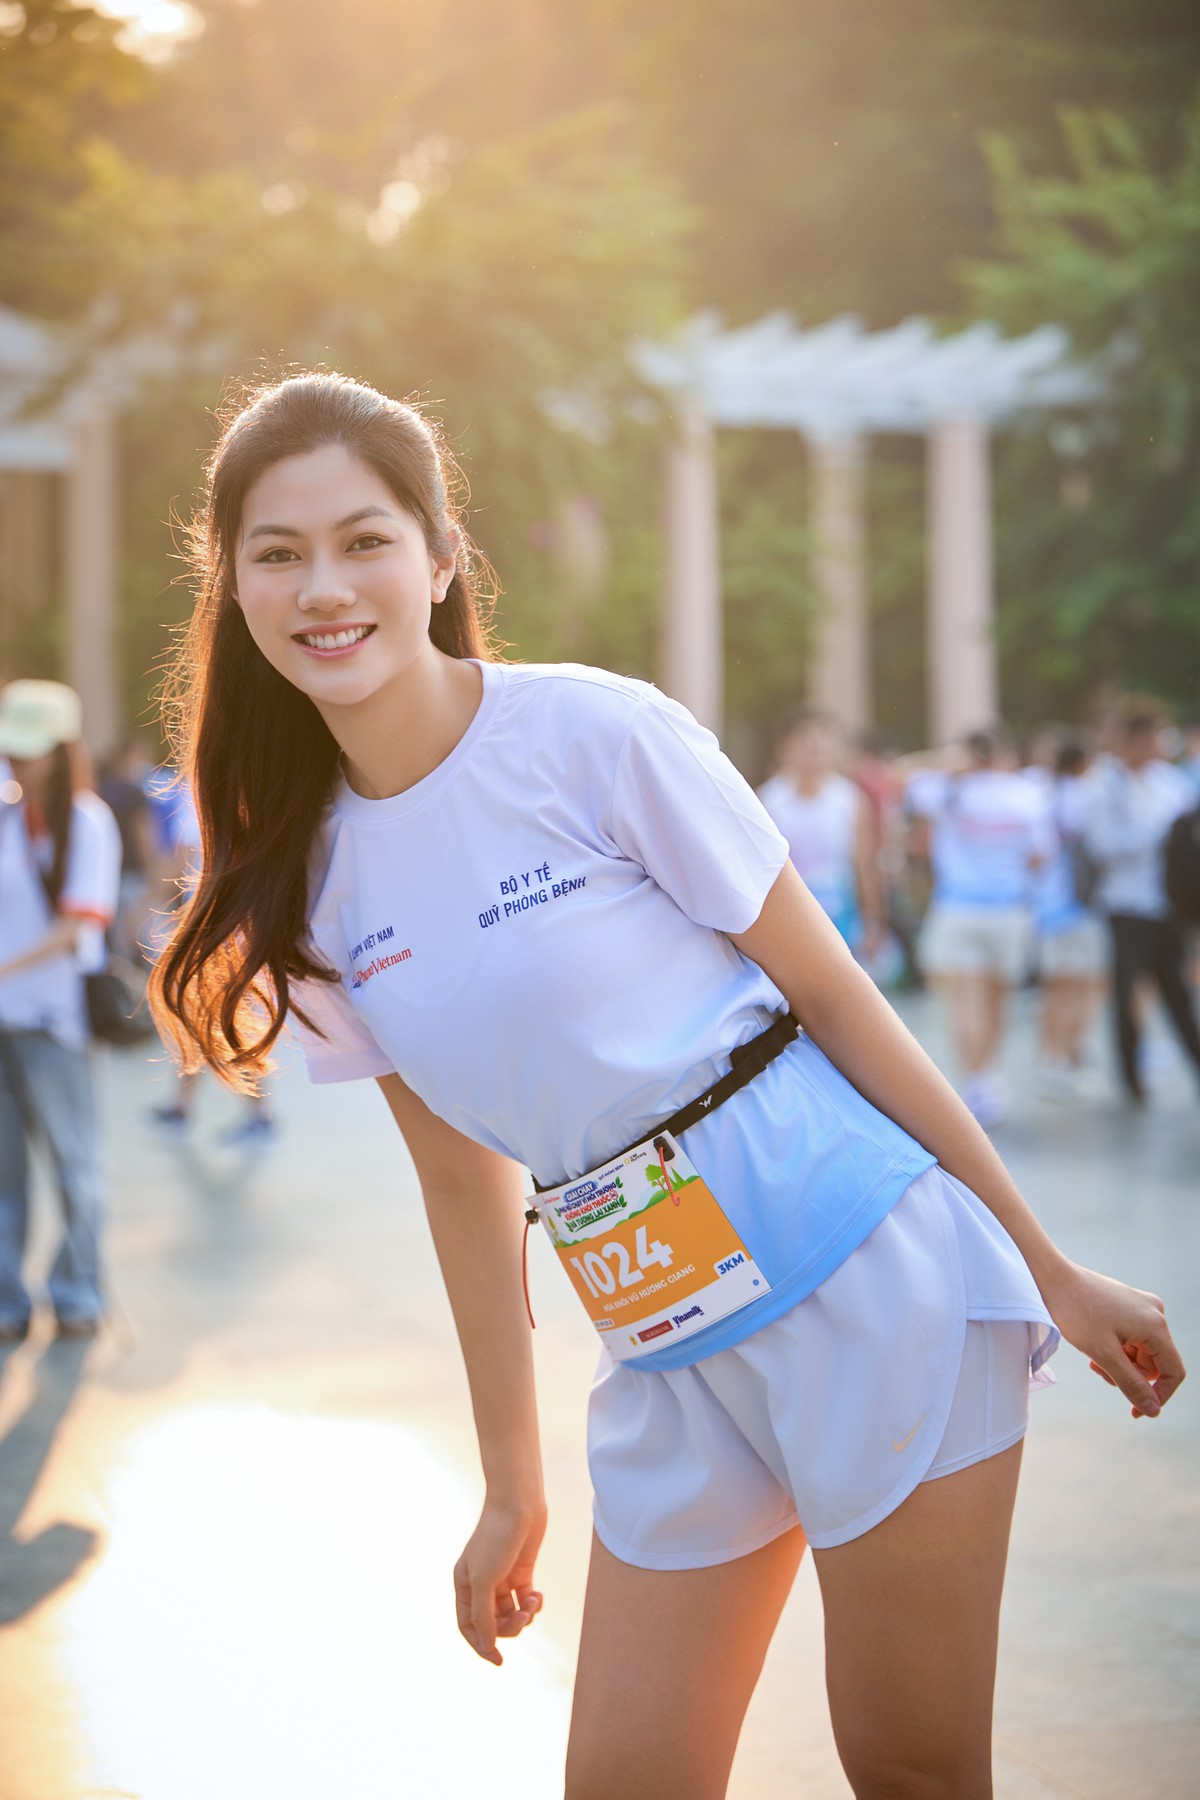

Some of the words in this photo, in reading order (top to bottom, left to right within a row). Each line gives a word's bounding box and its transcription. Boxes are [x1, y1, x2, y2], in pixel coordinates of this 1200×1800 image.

[500, 875, 518, 895] BỘ
[521, 872, 530, 887] Y
[534, 861, 552, 883] TẾ
[478, 904, 500, 928] QUỸ
[503, 889, 548, 918] PHÒNG
[551, 877, 586, 898] BỆNH
[363, 934, 376, 950] VIỆT
[377, 926, 395, 943] NAM
[565, 1209, 581, 1221] KHÔNG
[592, 1194, 611, 1209] THUỐC
[593, 1208, 603, 1219] LAI
[602, 1200, 621, 1213] XANH
[570, 1225, 674, 1298] 1024
[717, 1253, 745, 1275] 3KM
[628, 1291, 640, 1303] VŨ
[639, 1279, 668, 1298] HƯƠNG
[667, 1263, 696, 1284] GIANG
[672, 1304, 702, 1325] Vinamilk
